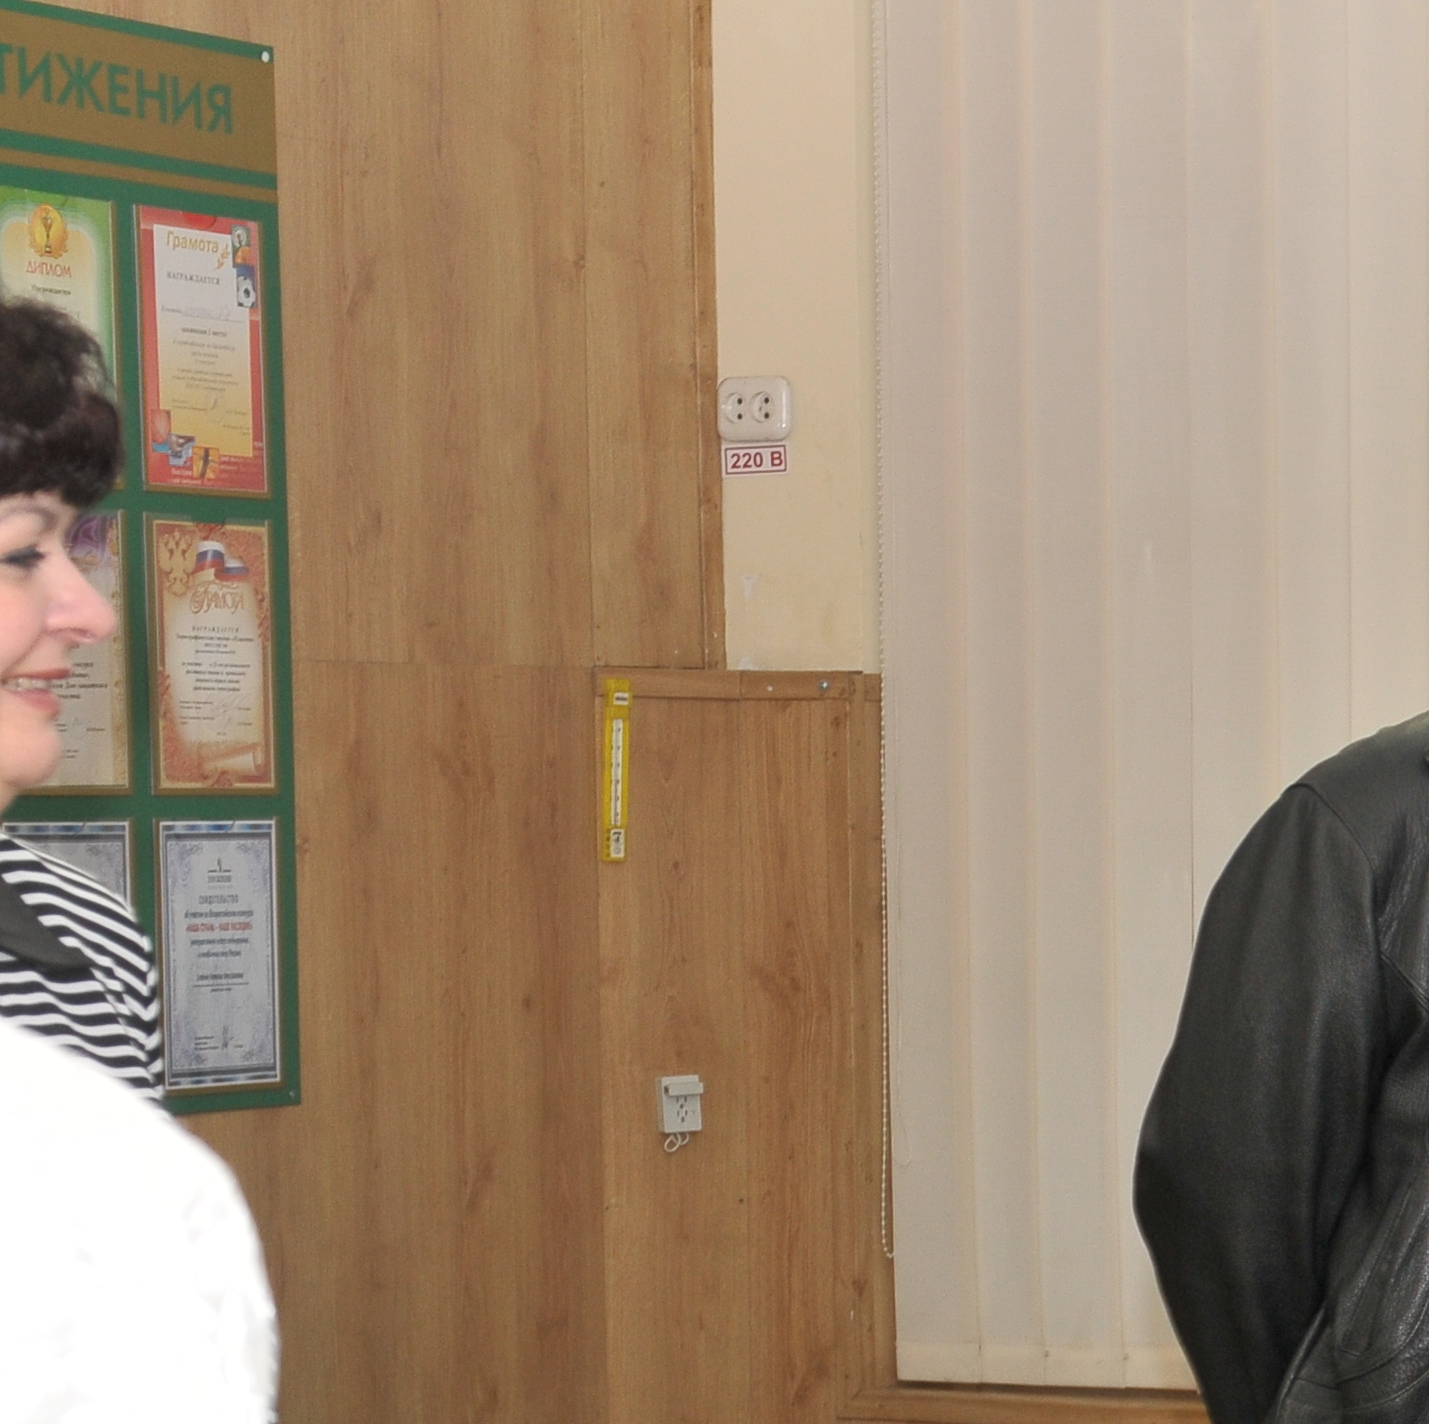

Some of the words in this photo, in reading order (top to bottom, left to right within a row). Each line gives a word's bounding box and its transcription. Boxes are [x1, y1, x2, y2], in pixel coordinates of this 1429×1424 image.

[166, 231, 219, 253] Грамота
[26, 261, 72, 278] ДИПЛОМ
[730, 451, 764, 470] 220
[770, 450, 783, 468] В
